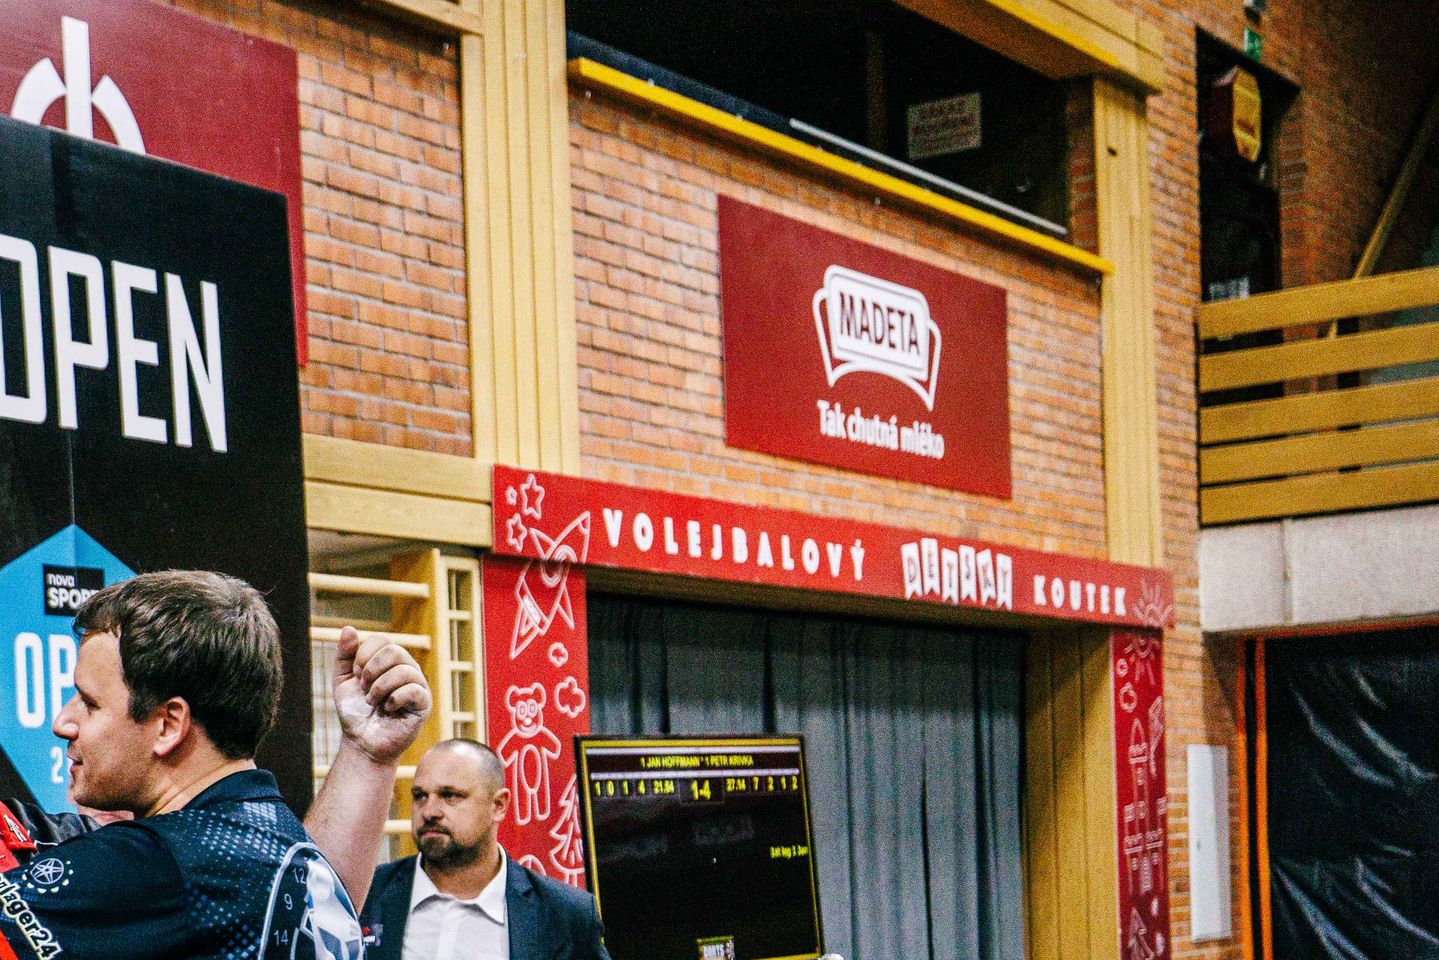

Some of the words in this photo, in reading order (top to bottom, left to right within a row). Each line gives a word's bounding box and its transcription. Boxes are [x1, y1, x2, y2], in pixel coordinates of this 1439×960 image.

[839, 291, 921, 356] MADETA
[817, 399, 847, 439] Tak
[847, 406, 899, 450] chutná
[602, 507, 866, 581] VOLEJBALOVÝ
[1033, 574, 1127, 617] KOUTEK
[47, 573, 75, 588] nova
[292, 866, 307, 885] 12
[284, 892, 294, 911] 9
[273, 929, 289, 947] 14
